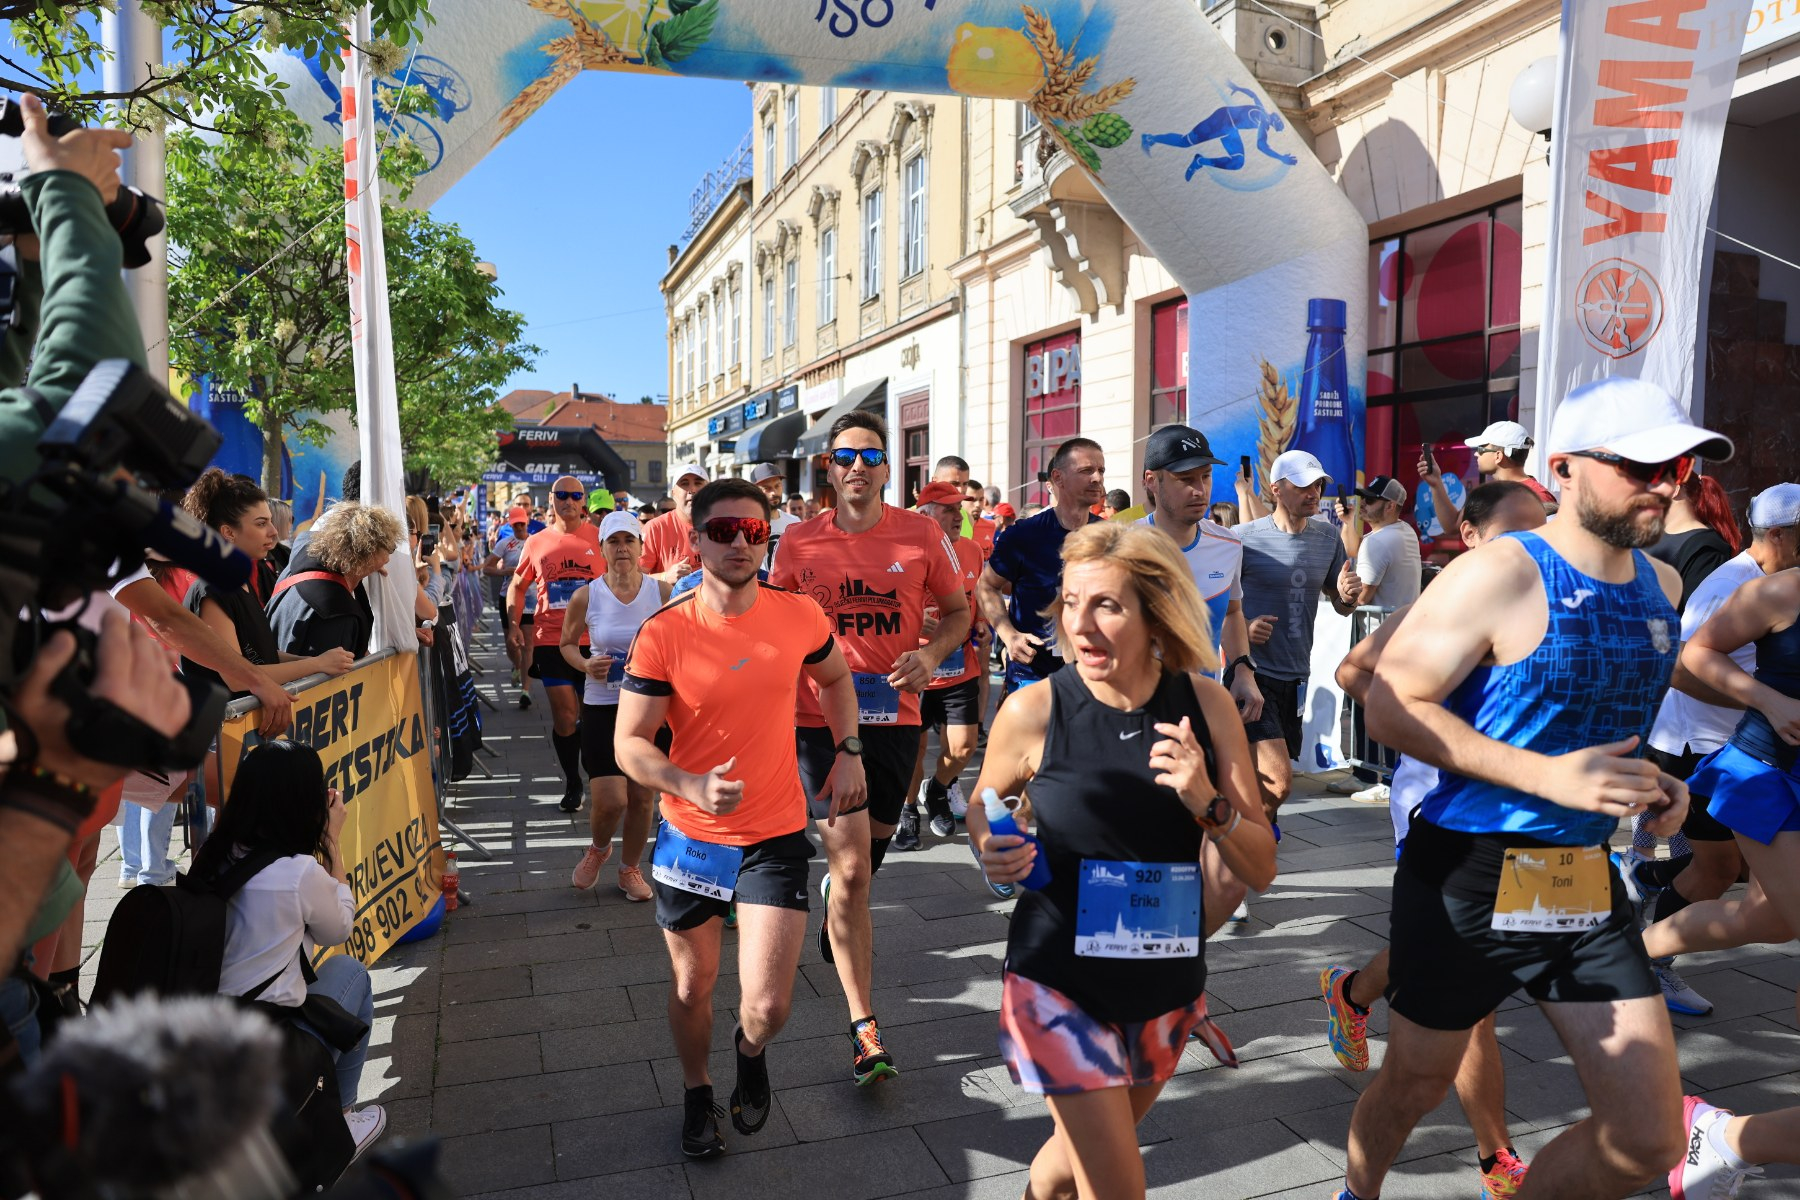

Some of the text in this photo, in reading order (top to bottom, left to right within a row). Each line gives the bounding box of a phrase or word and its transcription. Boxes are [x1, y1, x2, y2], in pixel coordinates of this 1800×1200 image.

[1582, 0, 1707, 247] YAMA
[1027, 344, 1081, 398] BIPA
[208, 393, 249, 403] SASTOJK
[1314, 400, 1343, 409] PRIRODNE
[1313, 408, 1344, 417] SASTOJKE
[518, 430, 559, 441] FERIVI
[524, 463, 560, 474] GATE
[859, 676, 875, 685] 850
[241, 682, 364, 758] BERT
[685, 846, 707, 861] Roko
[1559, 853, 1573, 866] 10
[1135, 870, 1162, 884] 920
[1552, 875, 1573, 888] Toni
[1130, 893, 1160, 907] Erika
[376, 888, 413, 939] 902
[1687, 1126, 1705, 1166] HOKA
